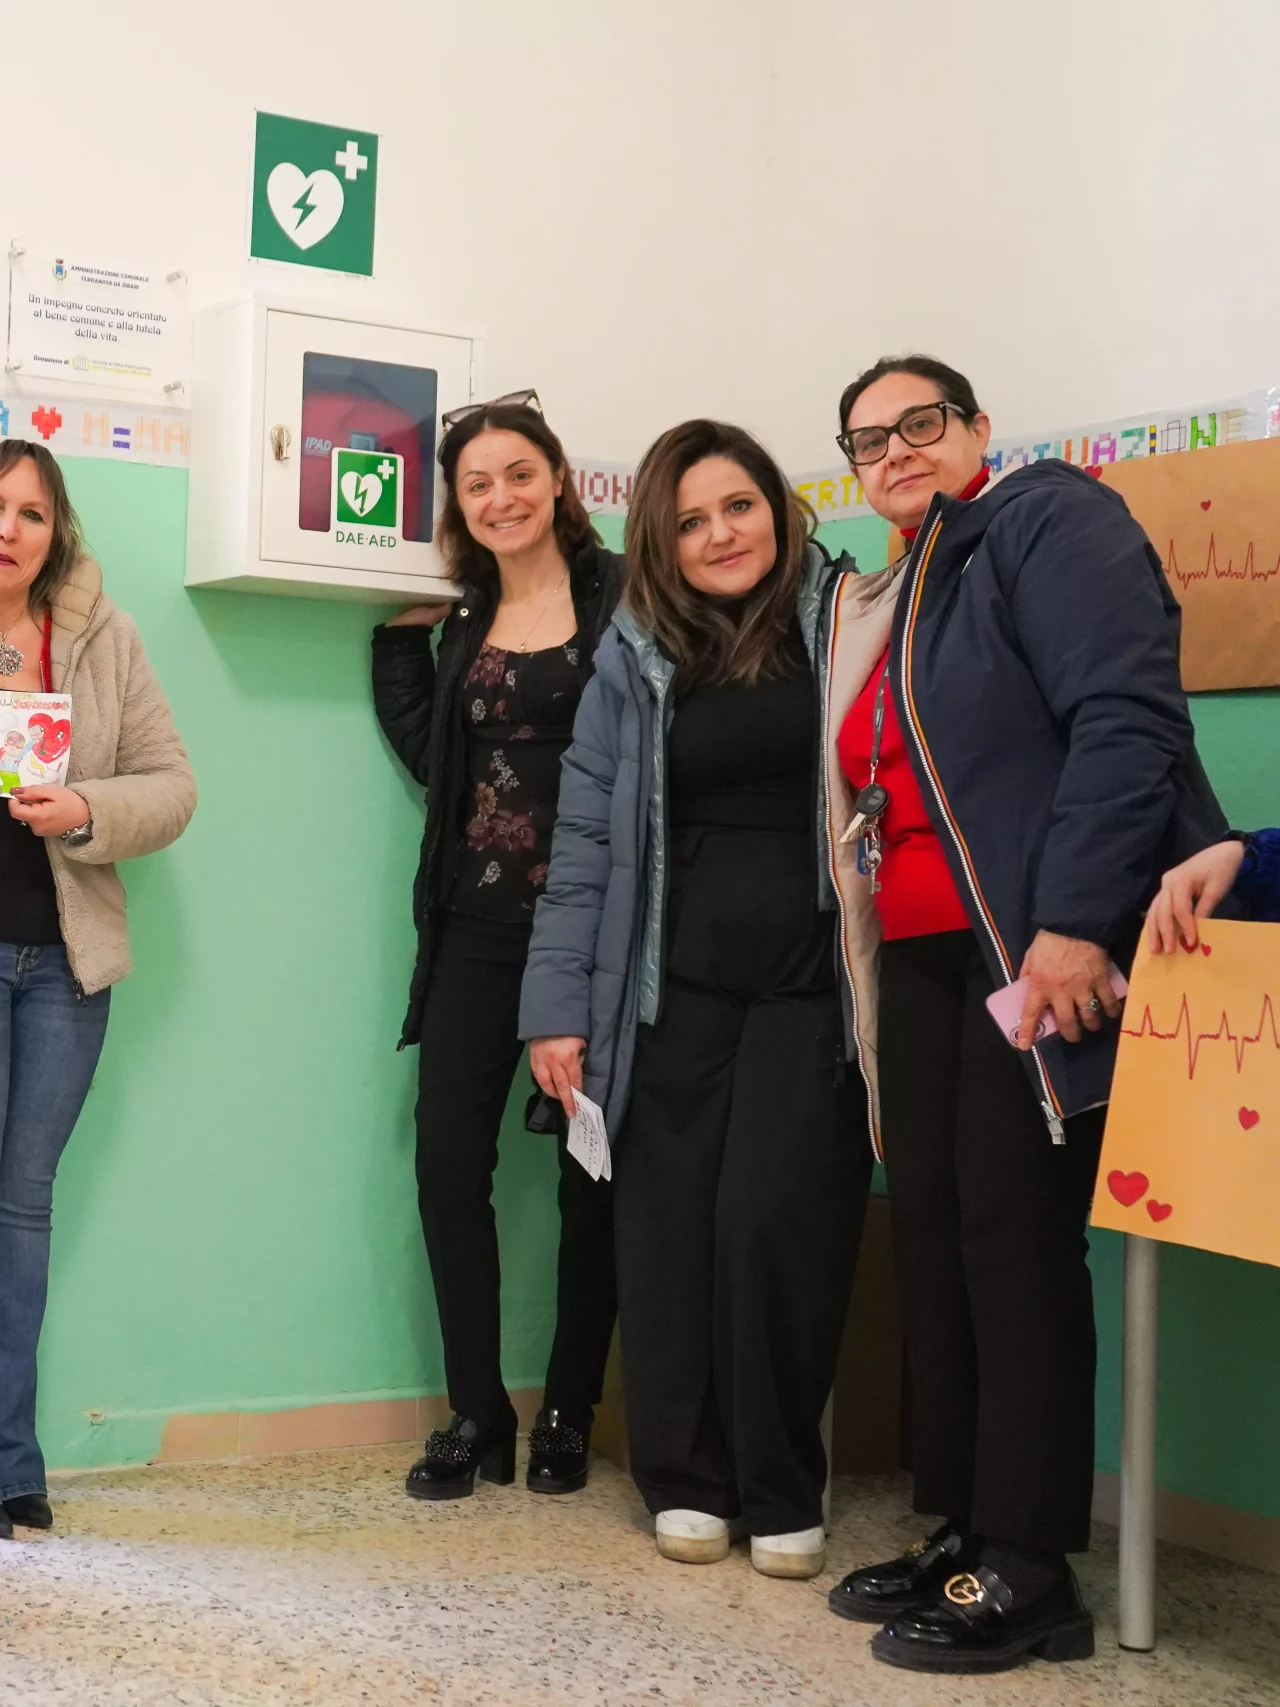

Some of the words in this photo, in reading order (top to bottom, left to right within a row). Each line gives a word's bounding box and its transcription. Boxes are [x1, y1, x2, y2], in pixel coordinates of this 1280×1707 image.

[70, 265, 119, 278] AMMINISTRAZIONE
[120, 273, 149, 283] COMUNALE
[80, 276, 112, 286] TERRANOVA
[28, 293, 41, 304] Un
[43, 296, 83, 311] impegno
[85, 303, 125, 316] concreto
[127, 309, 167, 323] orientato
[33, 309, 42, 318] al
[45, 310, 68, 322] bene
[70, 314, 106, 327] comune
[116, 320, 134, 331] alla
[136, 323, 162, 335] tutela
[74, 328, 98, 339] della
[100, 332, 120, 343] vita.
[33, 354, 63, 365] Donazione
